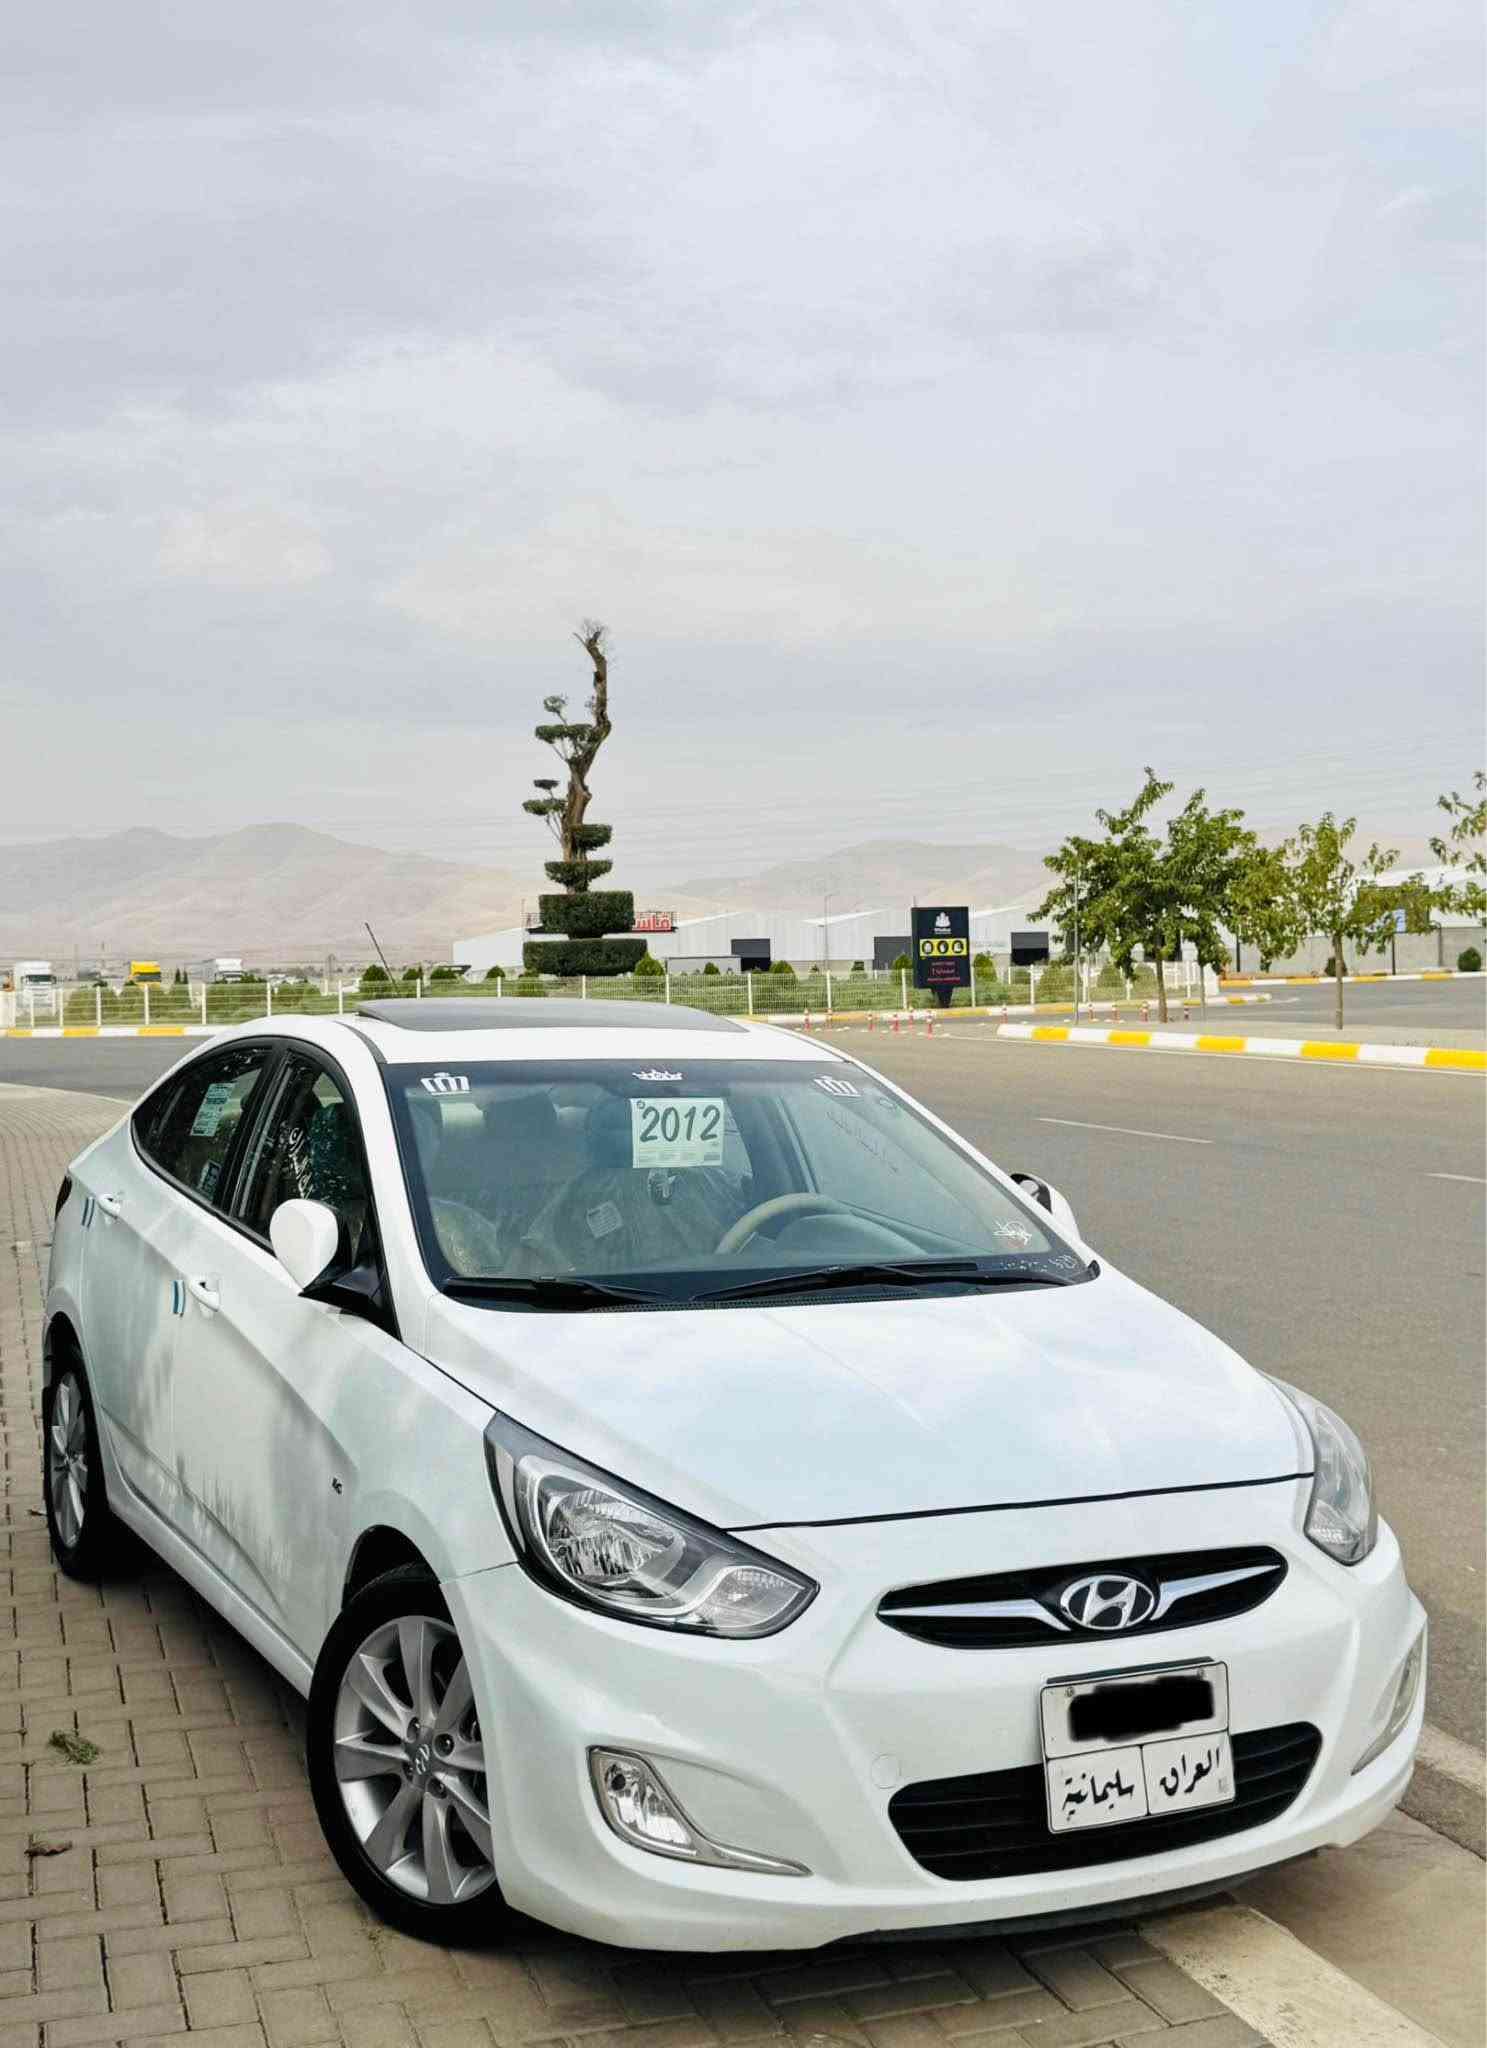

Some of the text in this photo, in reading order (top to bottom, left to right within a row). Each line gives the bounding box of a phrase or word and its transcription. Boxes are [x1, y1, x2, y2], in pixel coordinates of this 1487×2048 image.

[640, 1104, 721, 1143] 2012
[1062, 1769, 1135, 1821] سليمانية
[1159, 1748, 1219, 1796] العراق
